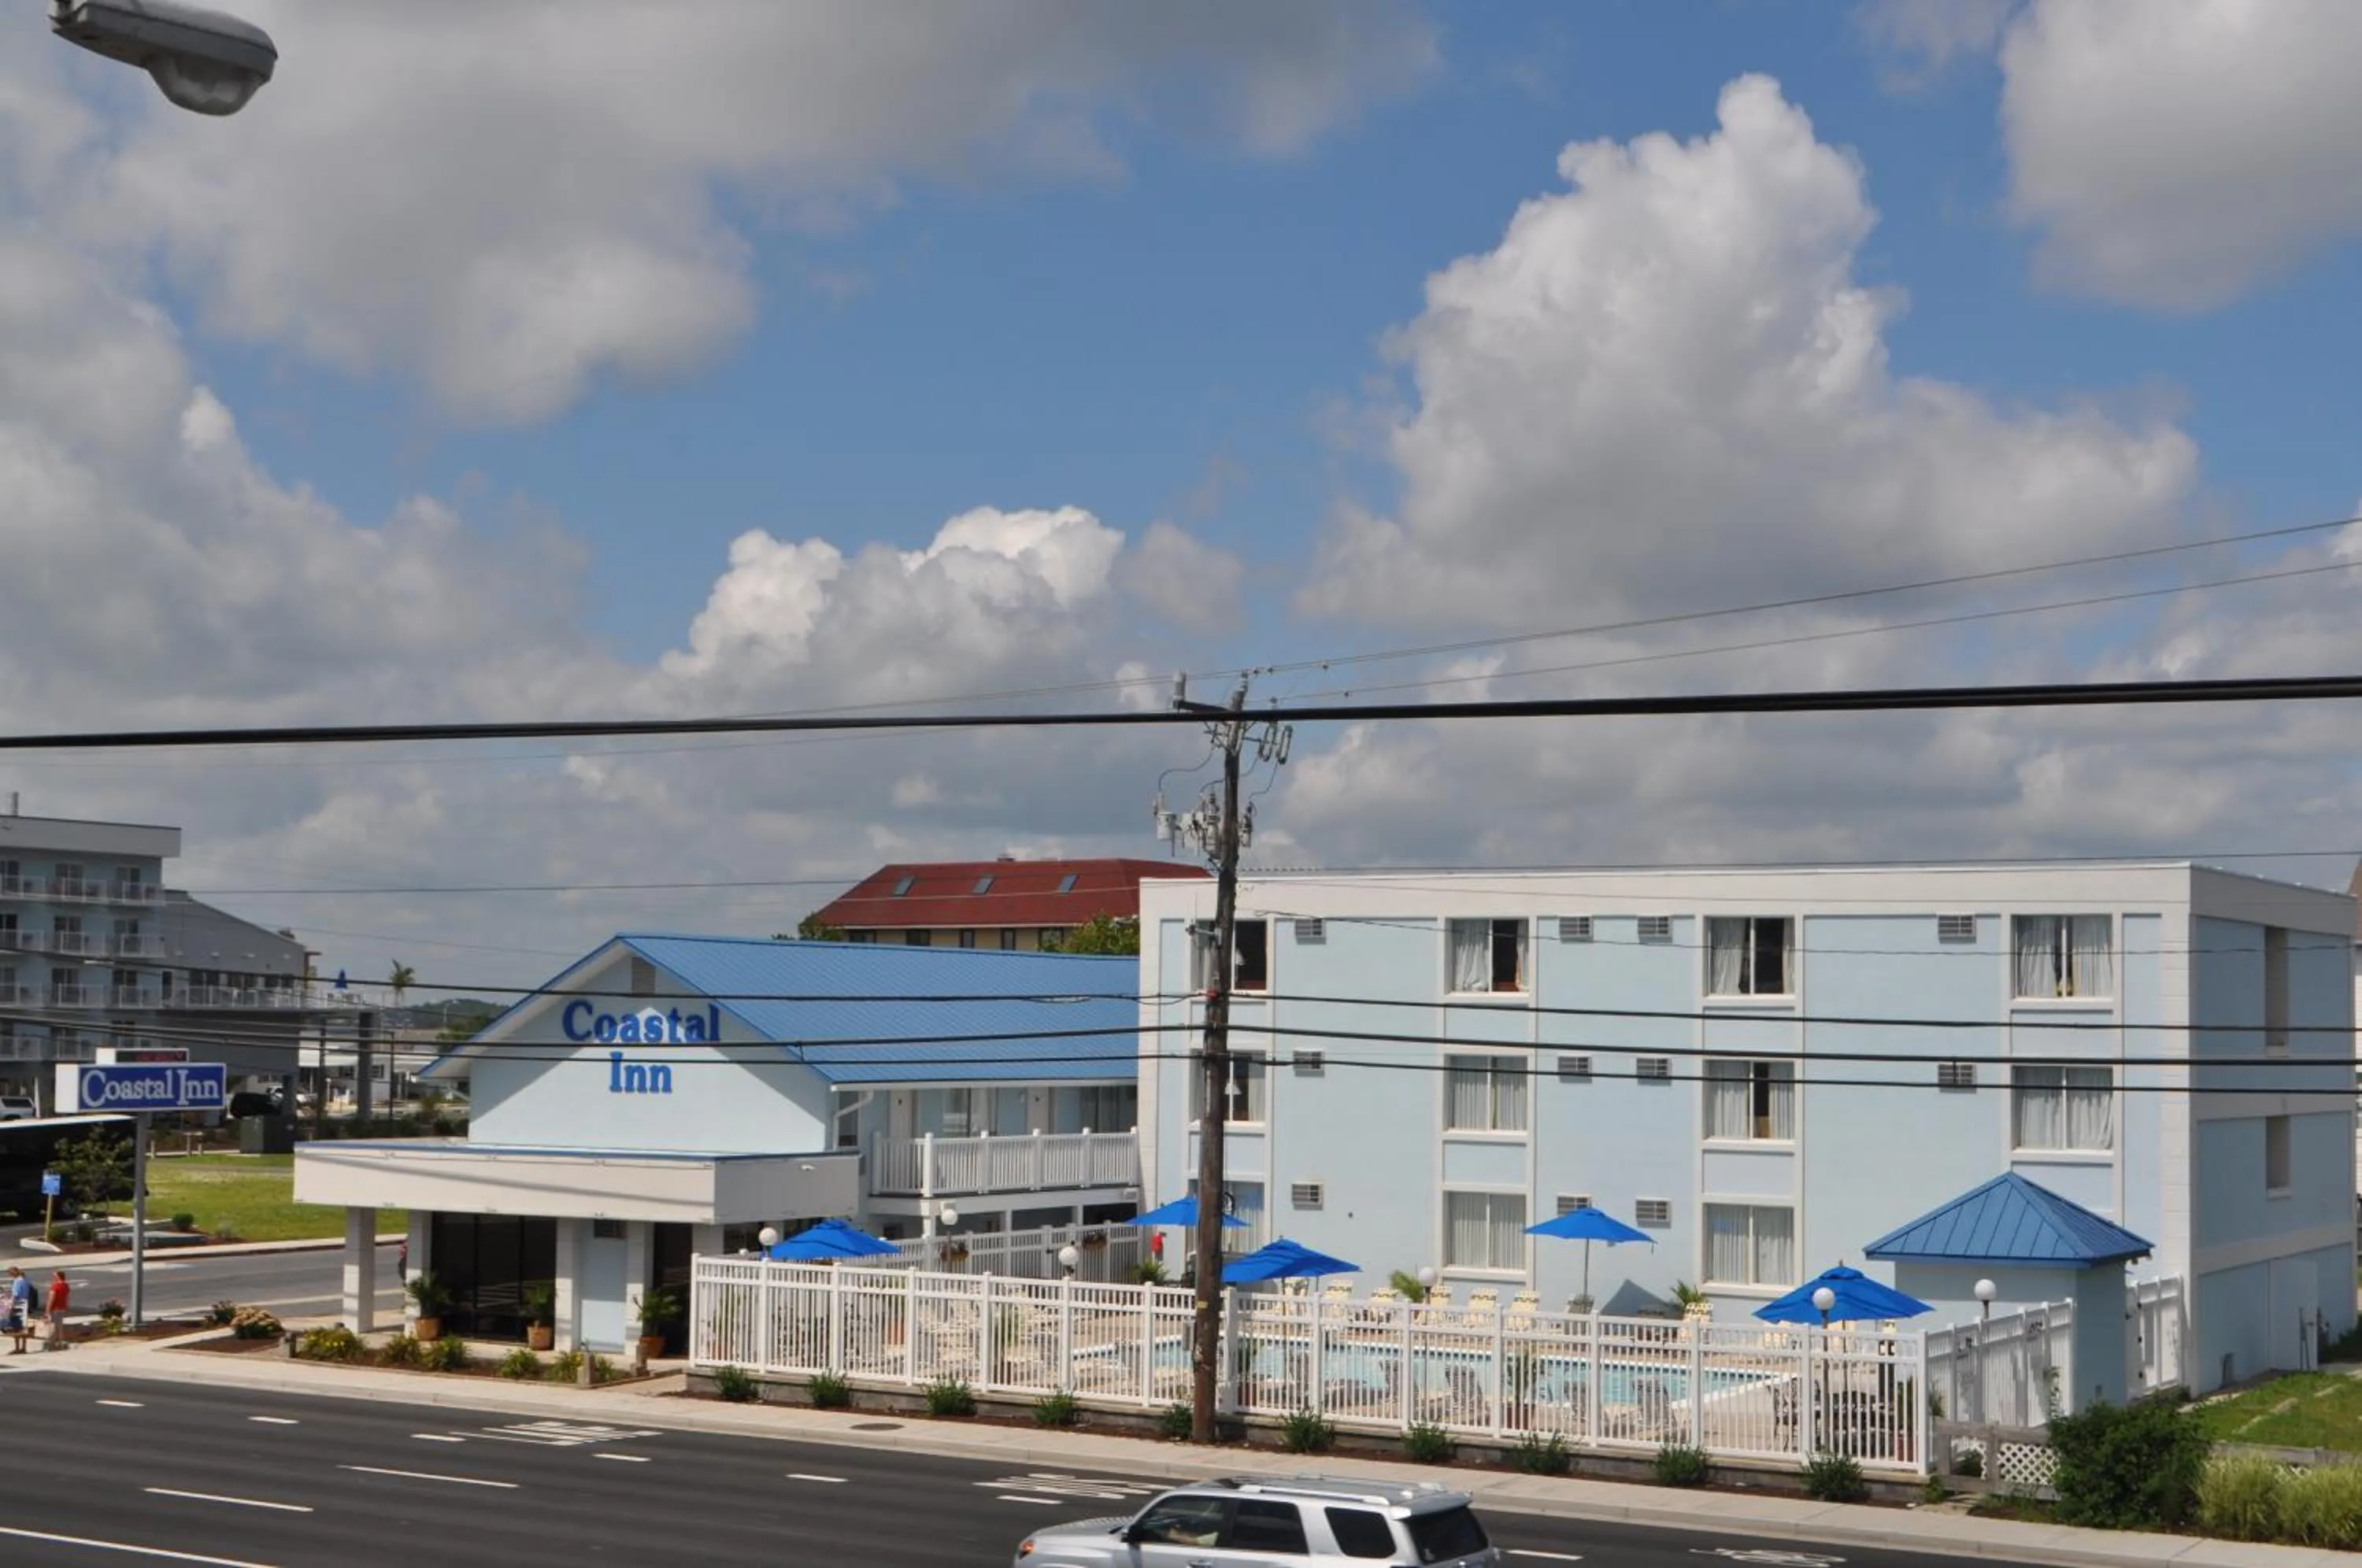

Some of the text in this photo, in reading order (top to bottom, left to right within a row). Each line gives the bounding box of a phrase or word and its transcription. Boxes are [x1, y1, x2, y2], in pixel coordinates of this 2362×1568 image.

[562, 999, 720, 1042] Coastal
[81, 1069, 220, 1108] Coastal Inn
[609, 1051, 672, 1093] Inn
